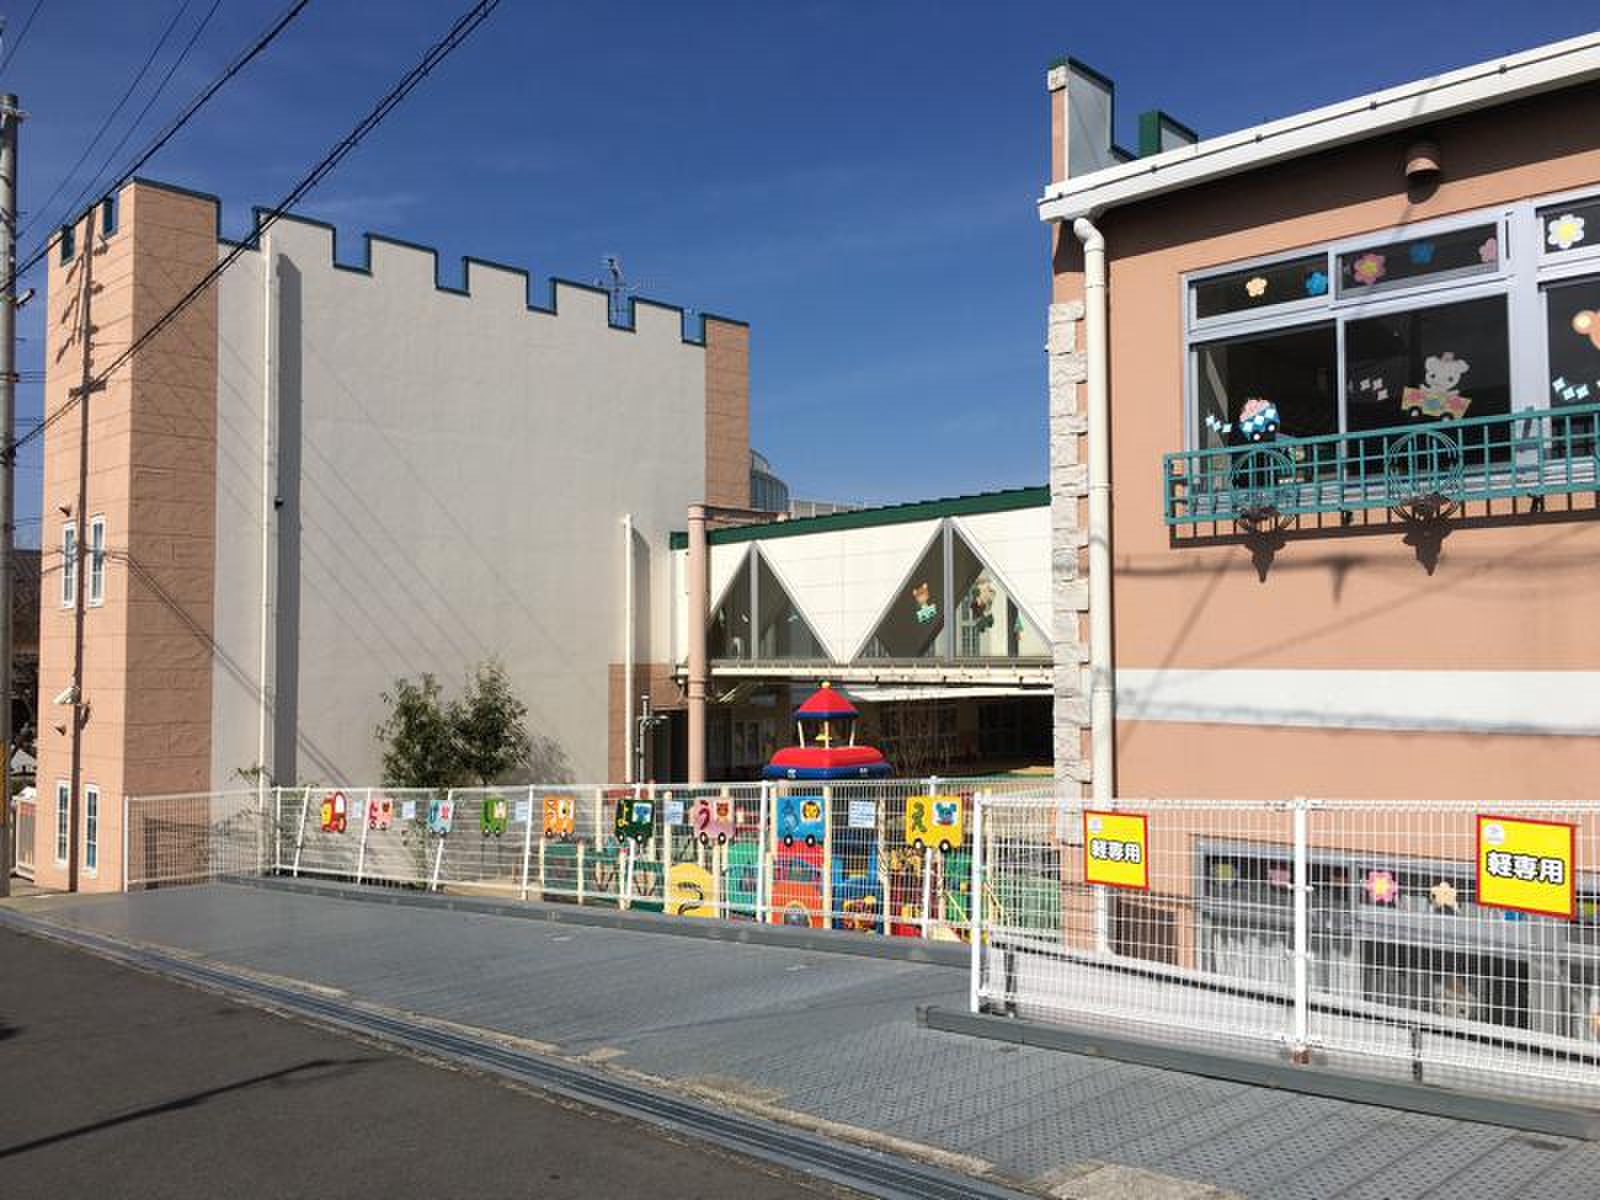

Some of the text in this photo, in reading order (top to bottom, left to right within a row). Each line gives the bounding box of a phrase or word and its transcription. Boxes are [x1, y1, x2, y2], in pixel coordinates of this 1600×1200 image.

[698, 799, 711, 831] う
[1090, 838, 1143, 864] 軽専用
[1486, 849, 1565, 885] 軽専用
